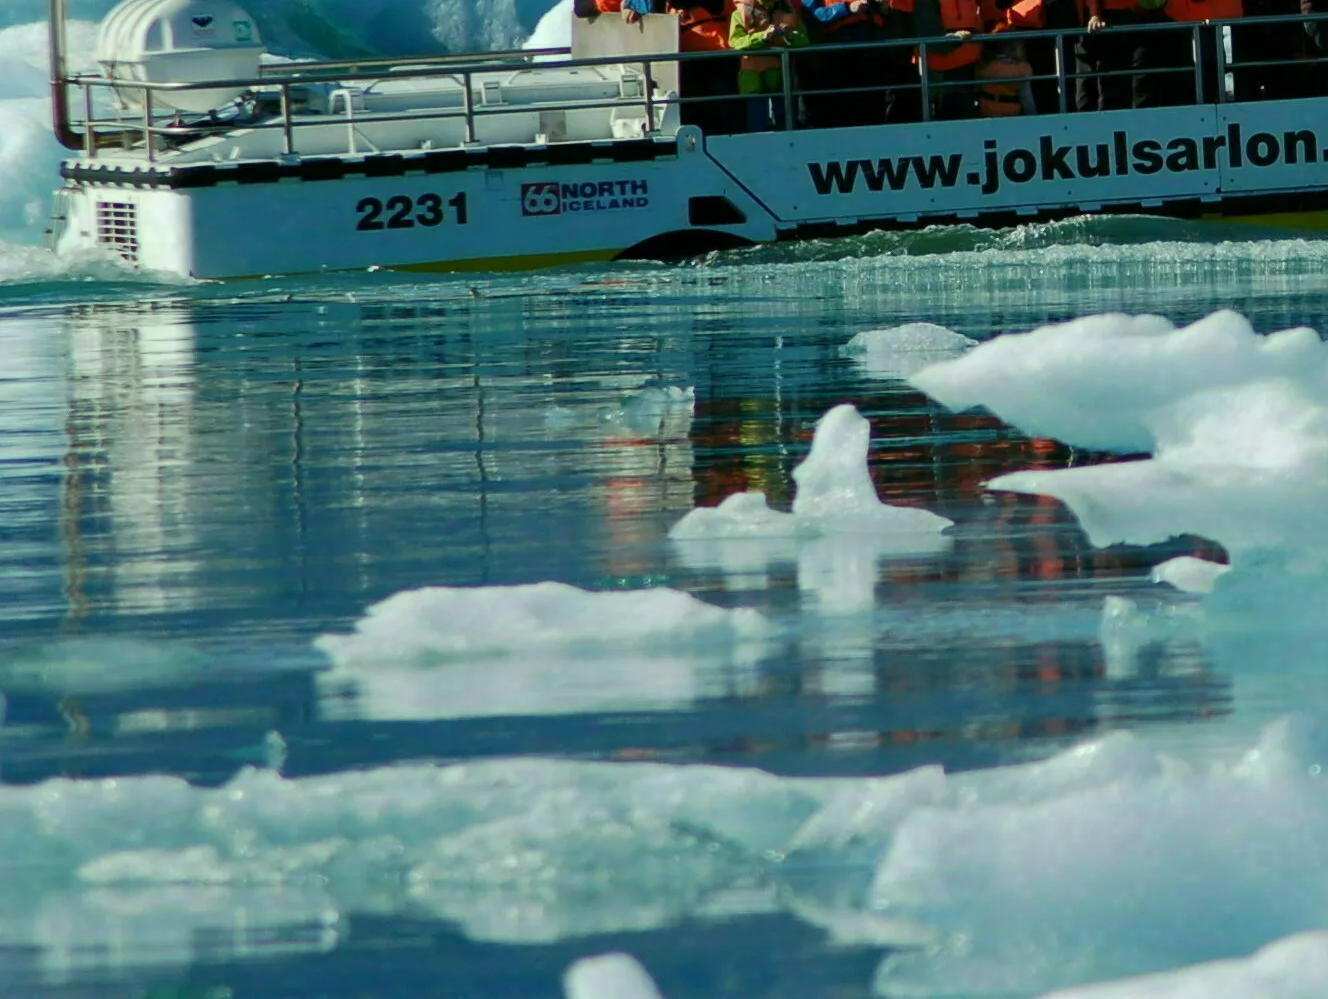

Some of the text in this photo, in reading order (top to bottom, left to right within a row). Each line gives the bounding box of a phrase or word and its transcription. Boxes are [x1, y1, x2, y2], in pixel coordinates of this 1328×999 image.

[355, 191, 468, 231] 2231
[524, 179, 649, 213] 66 NORTH
[562, 197, 649, 212] ICELAND
